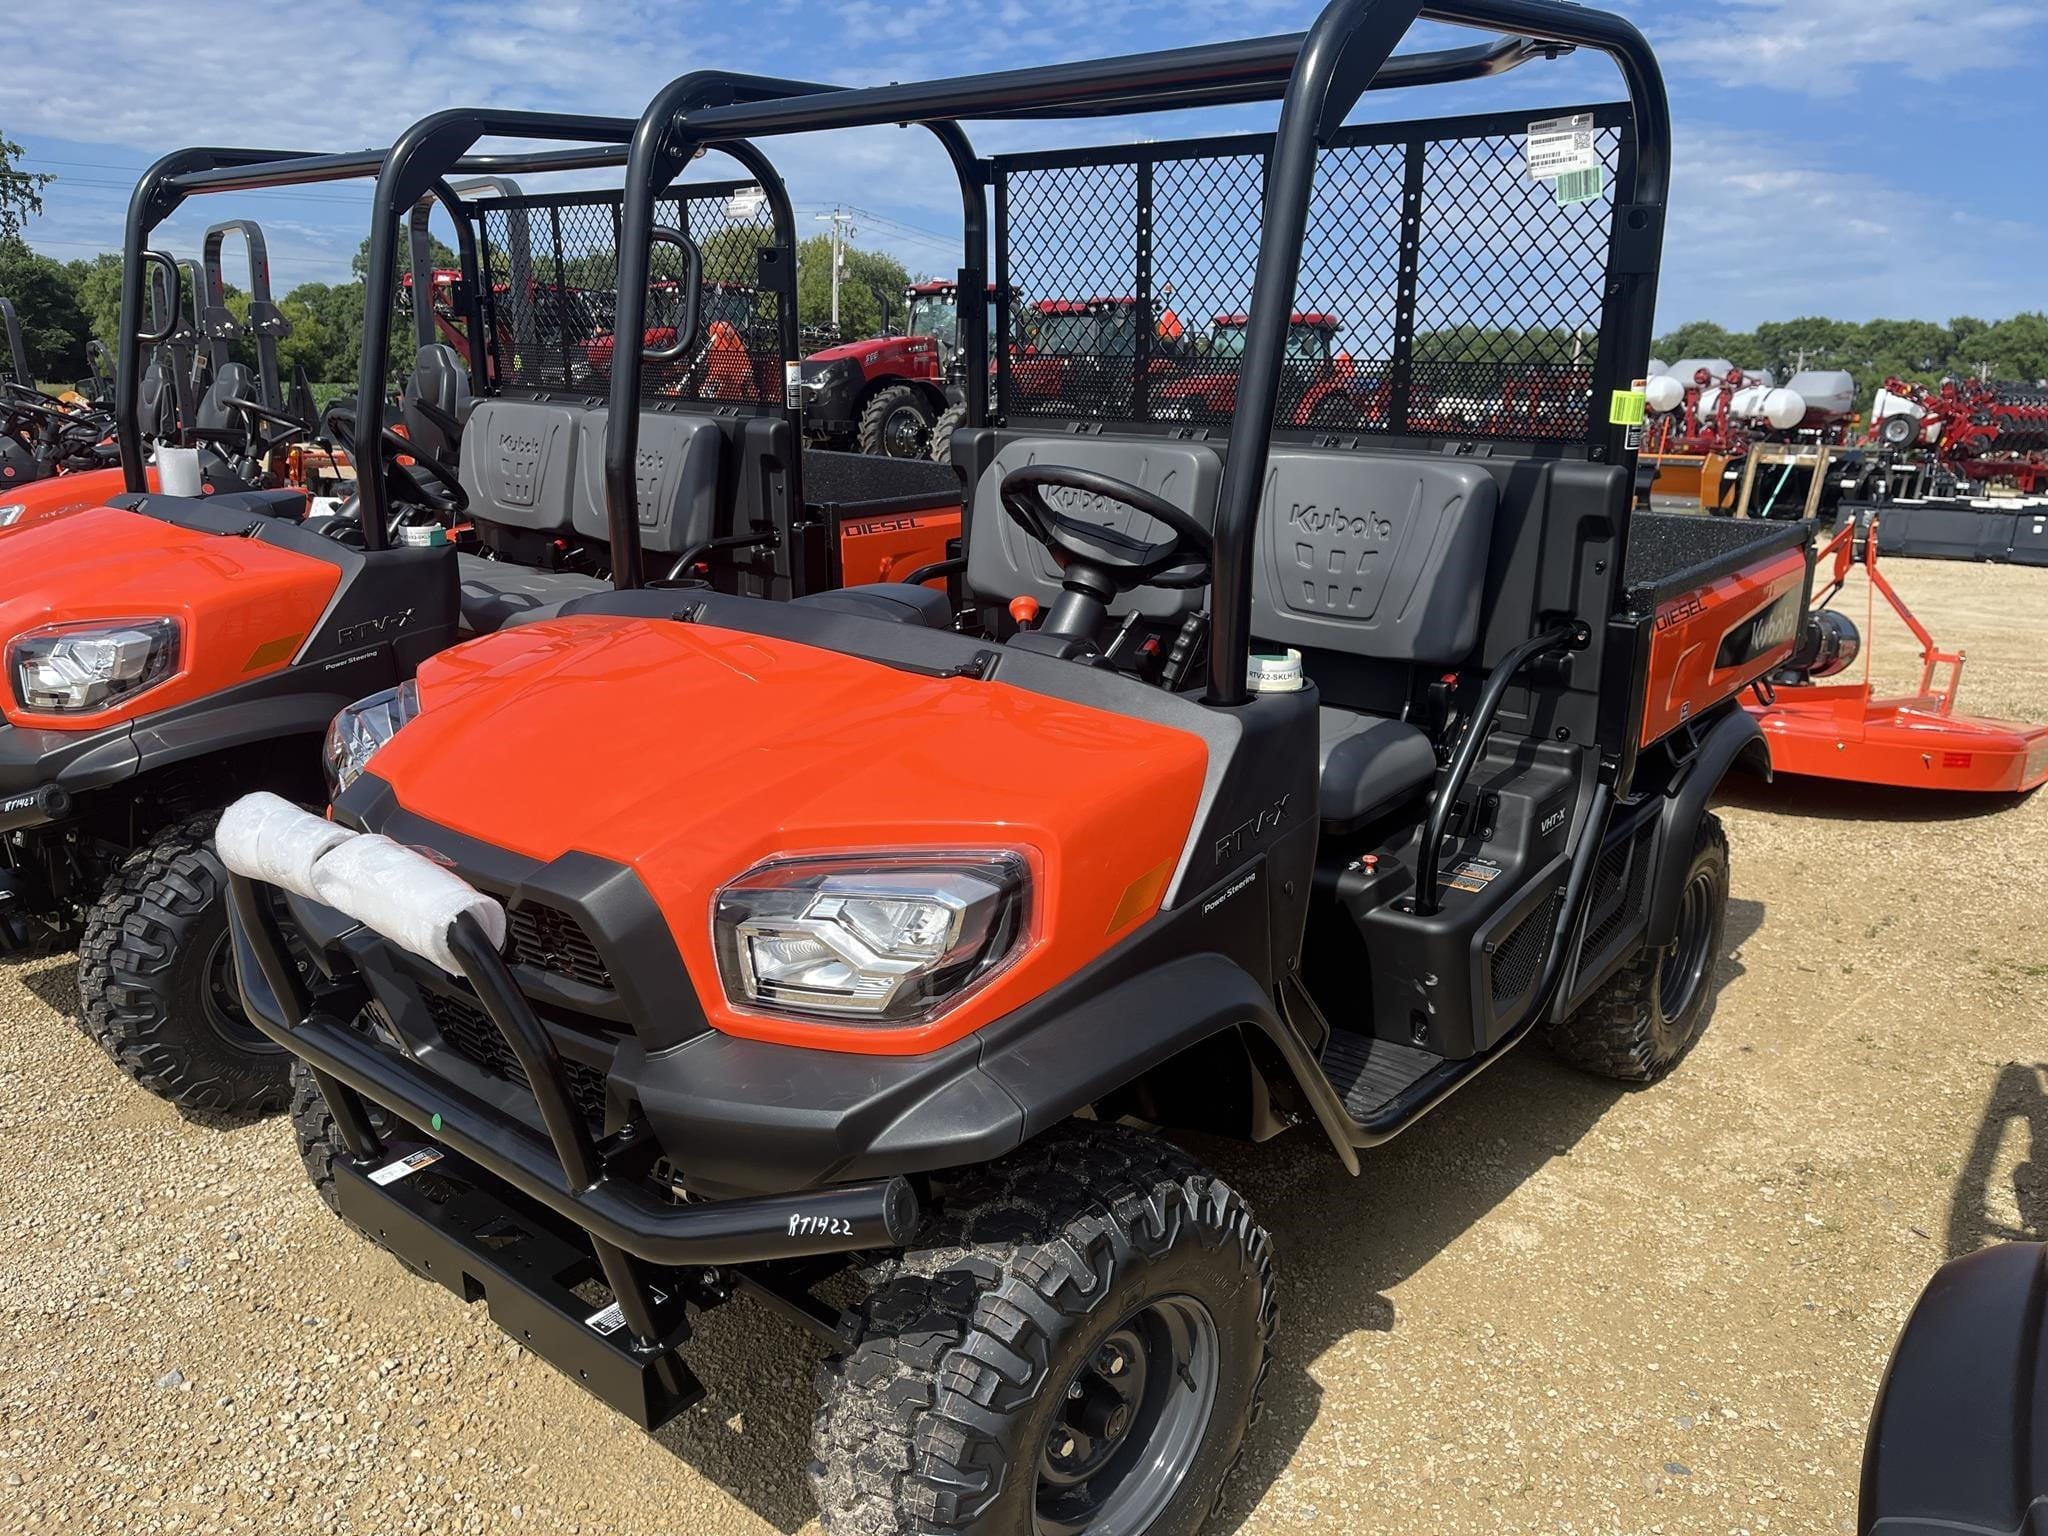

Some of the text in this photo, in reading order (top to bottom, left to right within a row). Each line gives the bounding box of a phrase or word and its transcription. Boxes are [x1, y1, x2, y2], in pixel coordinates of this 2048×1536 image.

[844, 518, 925, 537] DIESEL
[1289, 503, 1392, 540] Kubota
[338, 608, 417, 645] RTV-X
[1655, 599, 1708, 632] DIESEL
[1751, 607, 1795, 650] Kubota
[325, 650, 378, 671] Power Steering
[1215, 793, 1291, 865] RTV-X
[1541, 807, 1567, 833] VHT-X
[1204, 872, 1256, 914] Power Steering
[787, 1213, 854, 1237] RT1422
